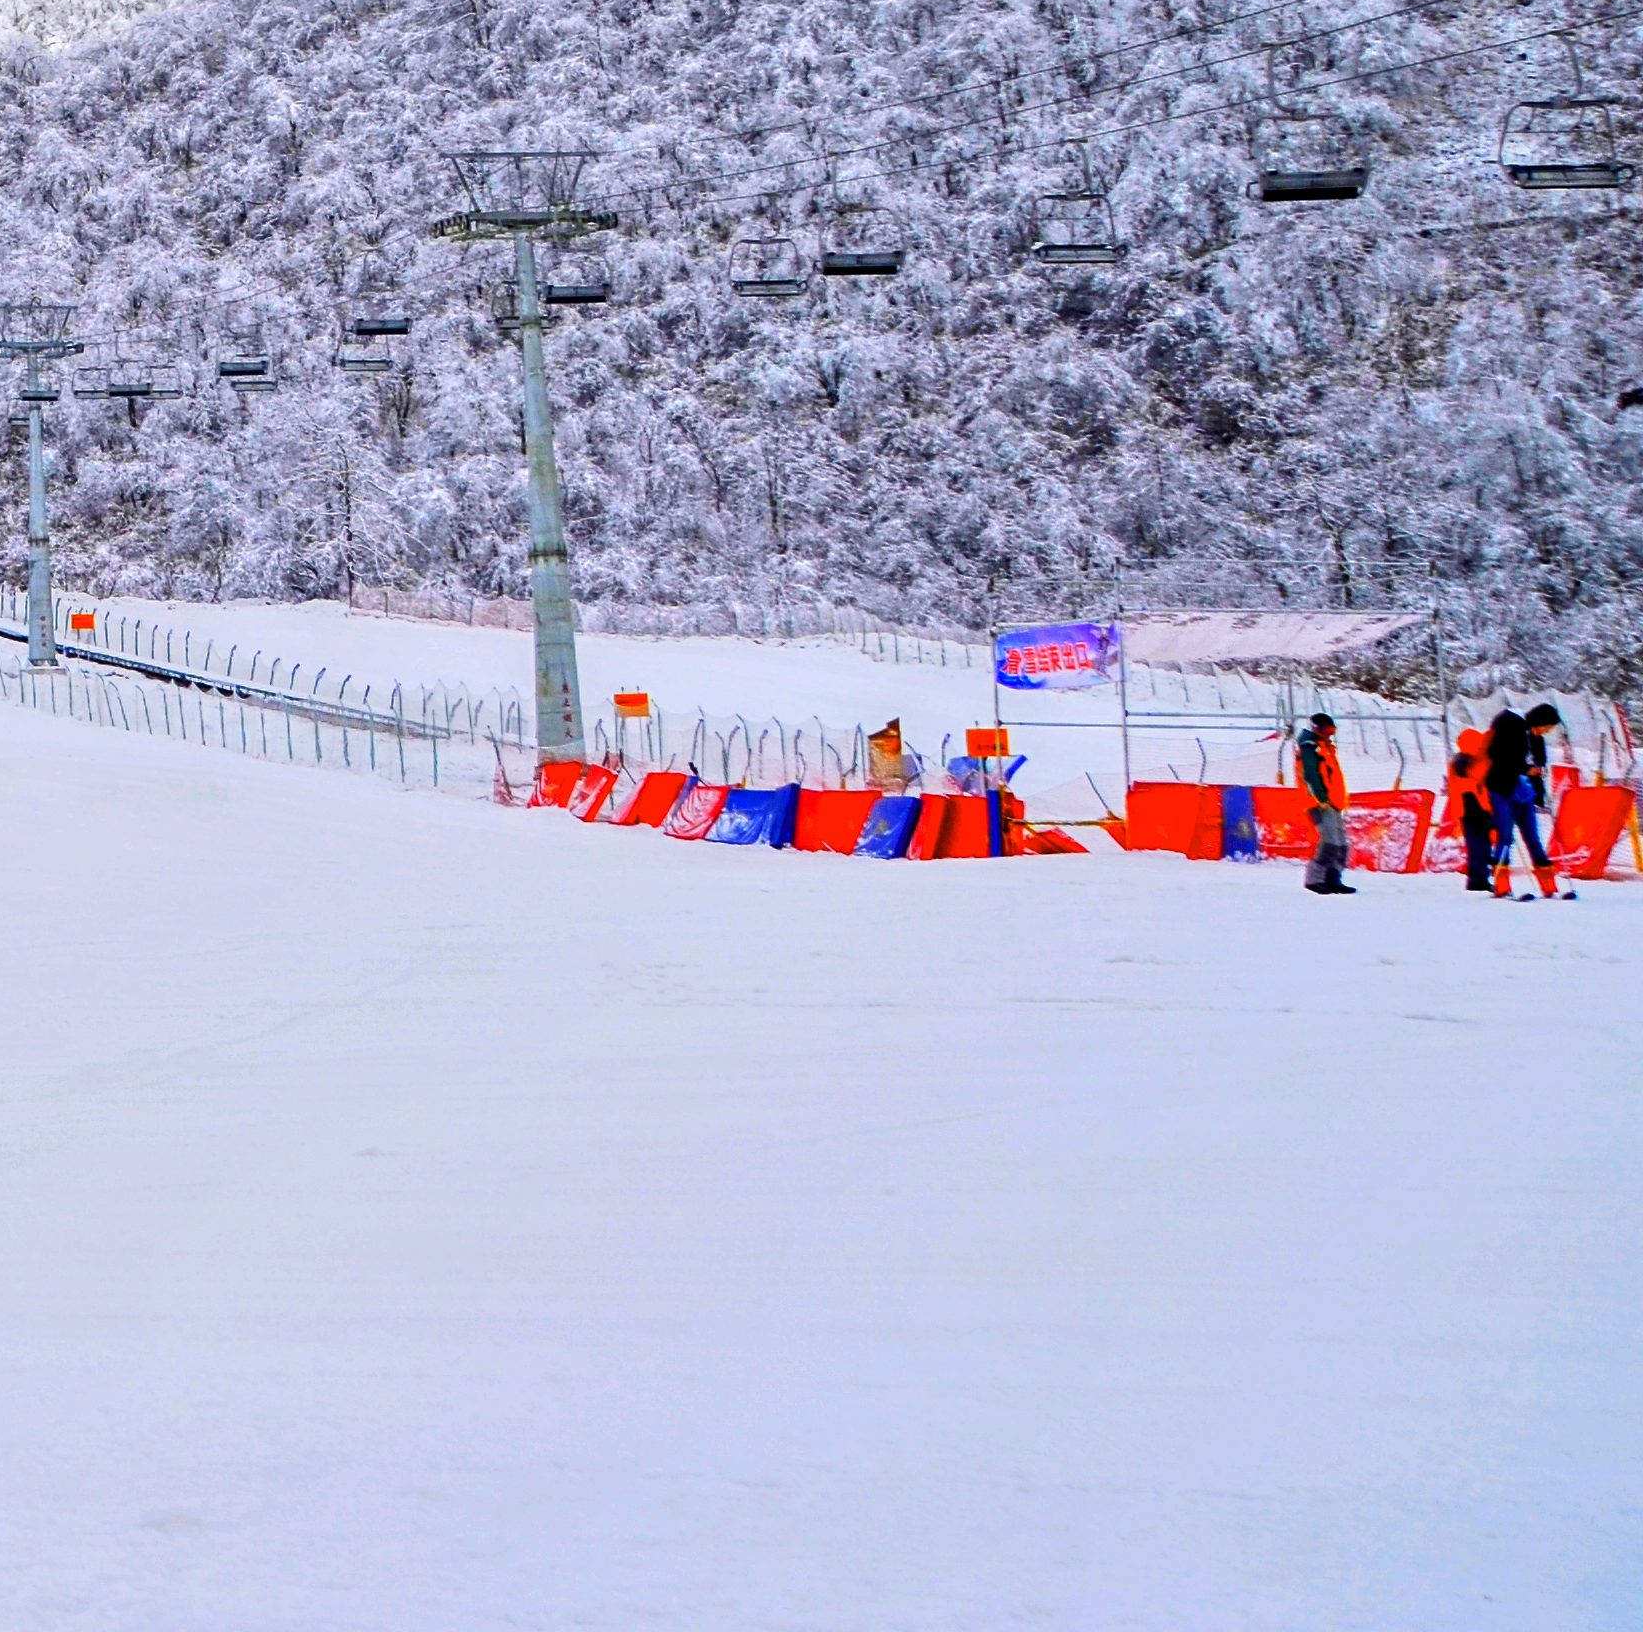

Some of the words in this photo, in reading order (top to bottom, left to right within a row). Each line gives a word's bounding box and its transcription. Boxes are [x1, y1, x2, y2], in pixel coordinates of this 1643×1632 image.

[1002, 641, 1094, 674] 滑雪结束出口
